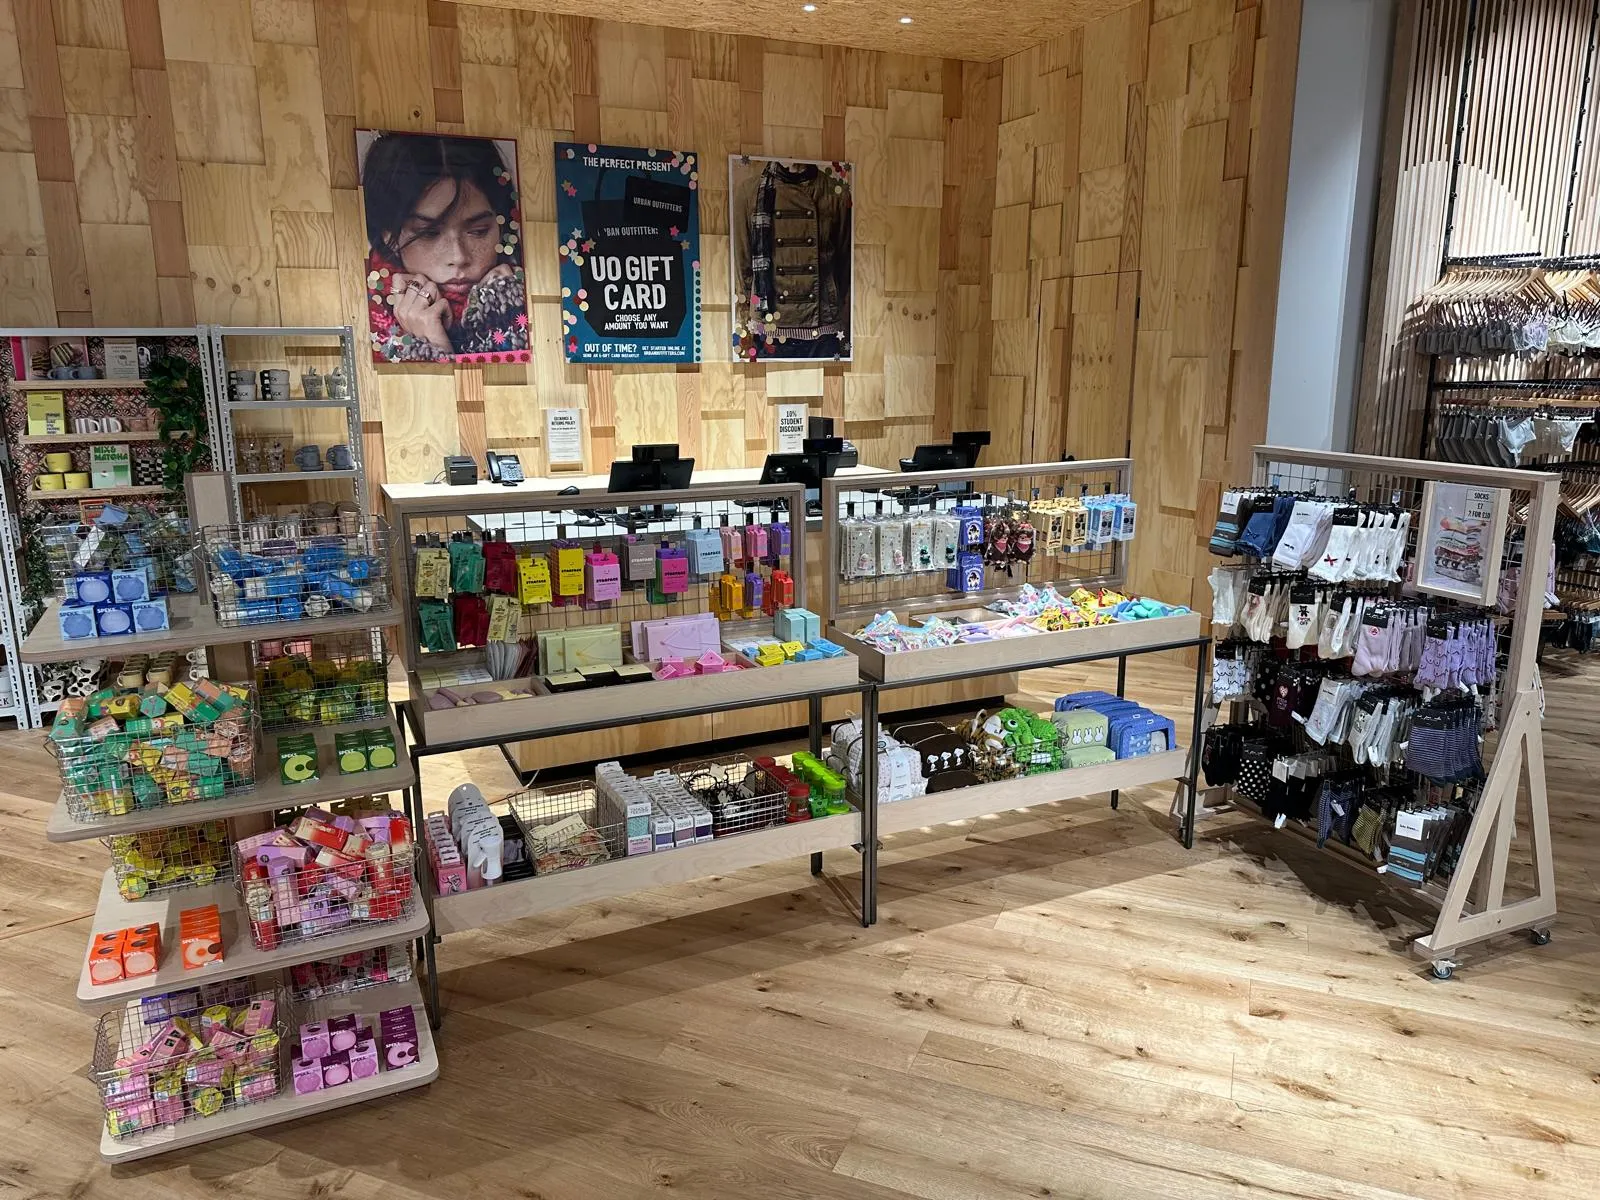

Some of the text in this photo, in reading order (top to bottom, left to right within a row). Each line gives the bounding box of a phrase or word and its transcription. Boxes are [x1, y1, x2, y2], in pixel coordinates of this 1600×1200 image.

[583, 157, 672, 172] THE PERFECT PRESENT
[633, 196, 683, 213] URBAN OUTFITTERS
[590, 256, 674, 282] UO GIFT
[604, 283, 667, 311] CARD
[615, 314, 657, 322] CHOOSE ANY
[604, 321, 669, 331] AMOUNT YOU WANT
[584, 343, 637, 353] OUT OF TIME?
[786, 410, 797, 418] 10%
[1474, 492, 1490, 500] SOCKS
